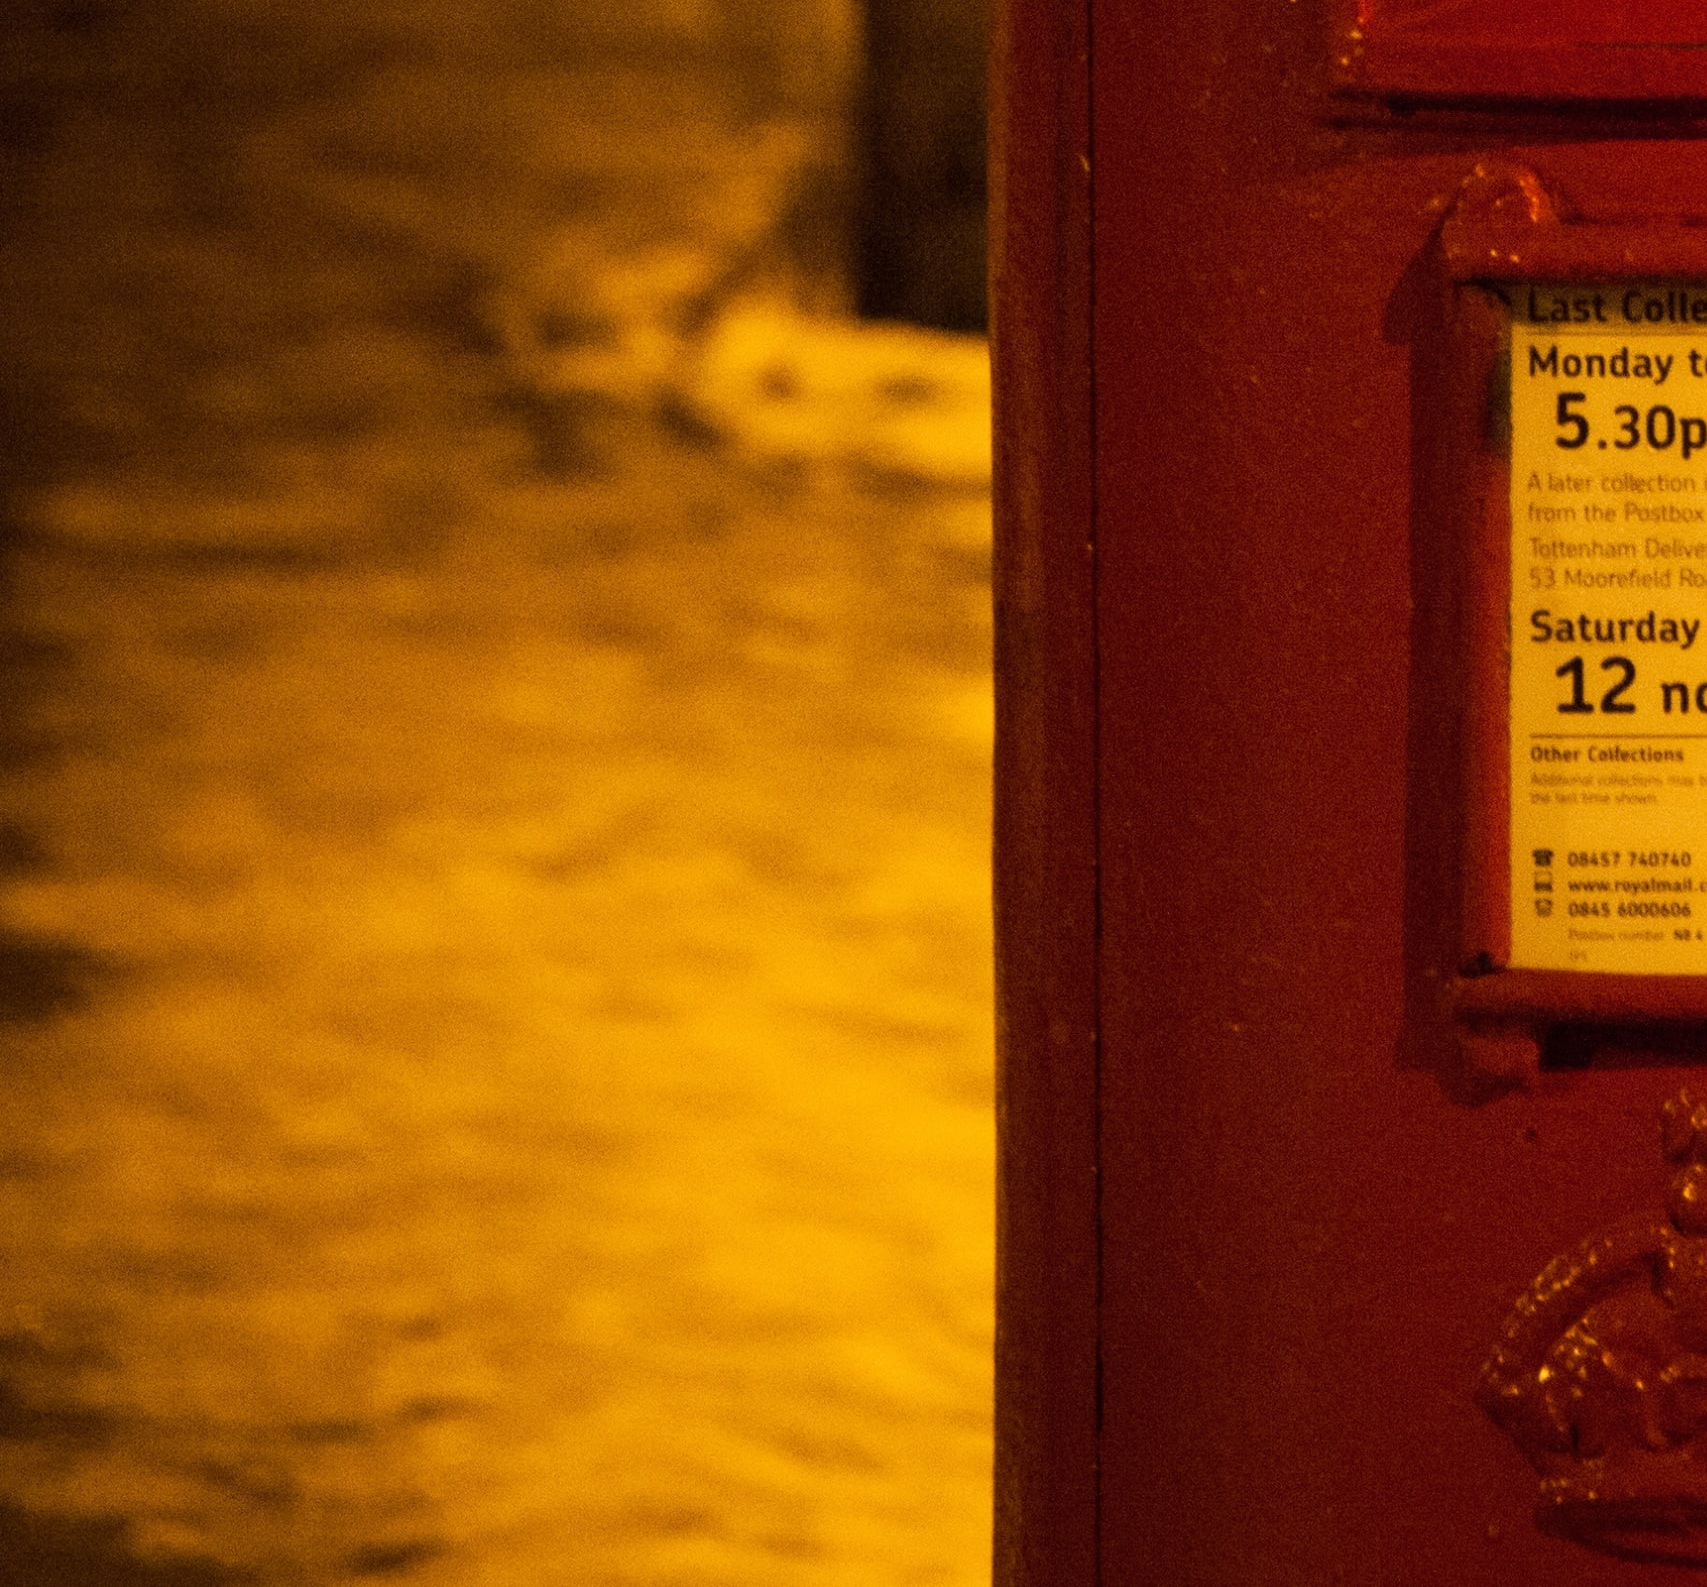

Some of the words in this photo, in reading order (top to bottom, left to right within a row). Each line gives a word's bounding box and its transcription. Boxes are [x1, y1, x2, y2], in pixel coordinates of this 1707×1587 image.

[1527, 290, 1604, 323] Last
[1527, 343, 1673, 385] Monday
[1527, 471, 1542, 491] A
[1547, 472, 1592, 493] later
[1601, 472, 1695, 494] collection
[1527, 500, 1576, 525] from
[1583, 504, 1616, 523] the
[1623, 500, 1704, 524] Postbox
[1529, 536, 1637, 559] Tottenham
[1529, 566, 1556, 590] 53
[1530, 608, 1700, 650] Saturday
[1556, 656, 1636, 714] 12
[1530, 745, 1580, 763] Other
[1588, 745, 1684, 762] Collections
[1567, 851, 1621, 868] 08457
[1629, 851, 1691, 868] 740740
[1568, 901, 1610, 918] 0845
[1617, 901, 1691, 918] 6000606
